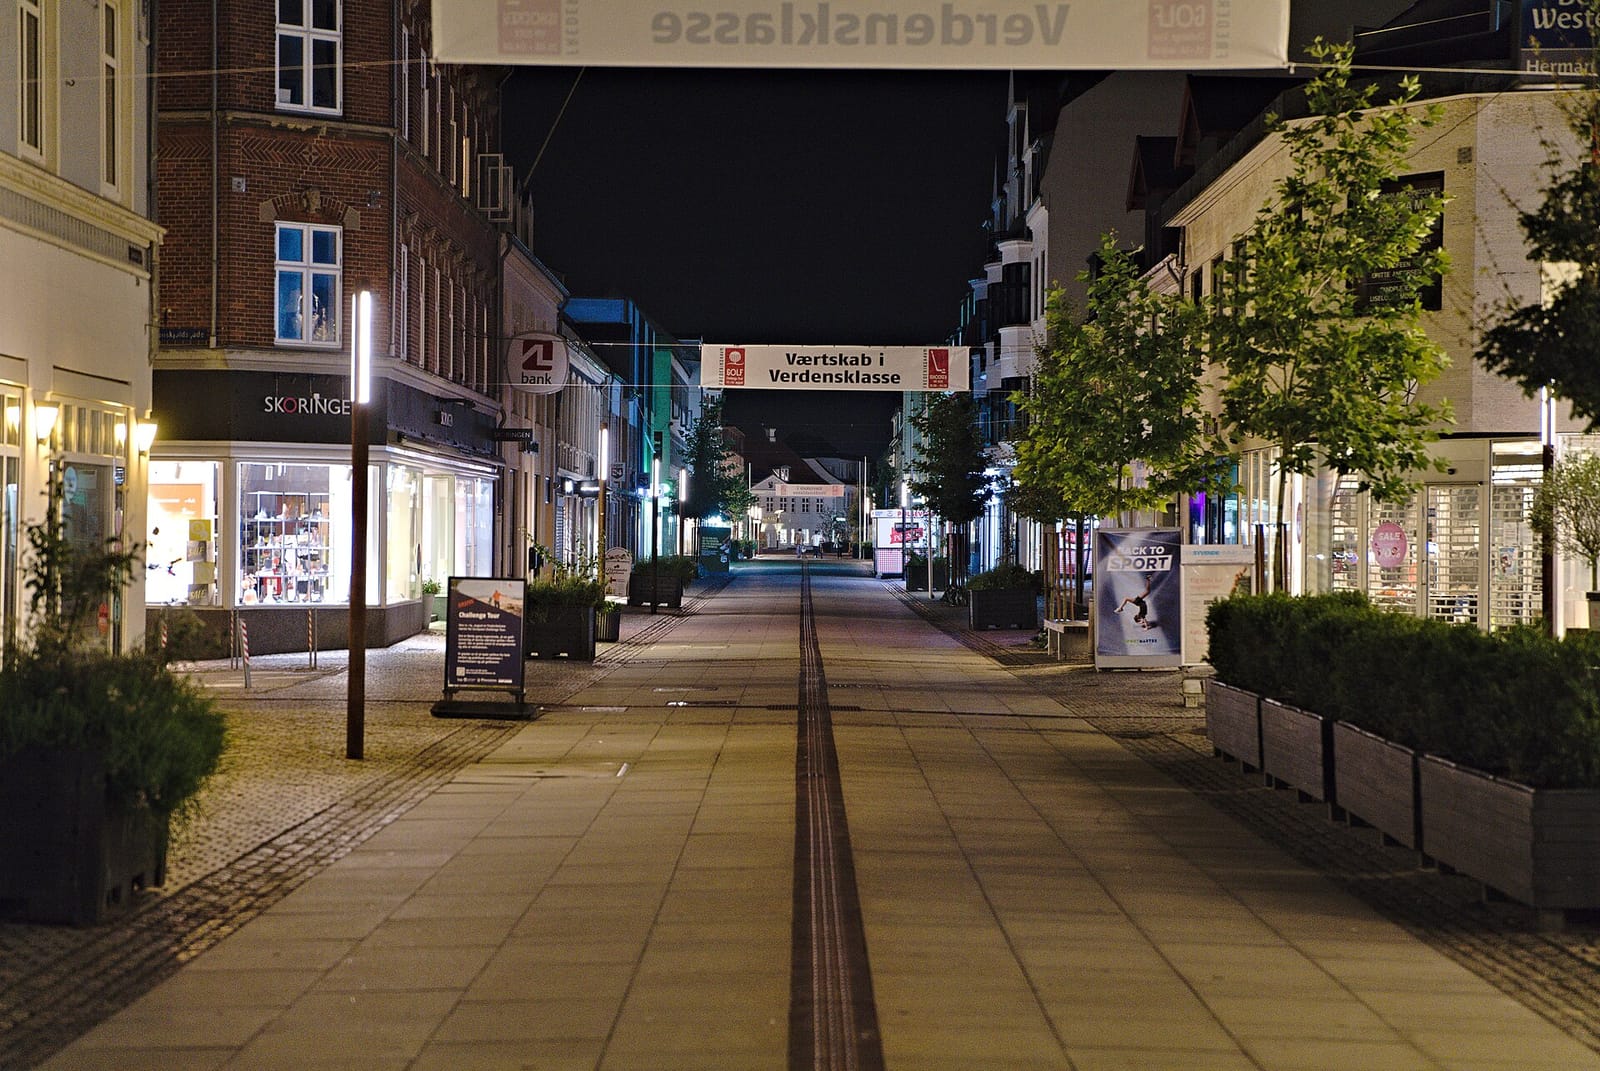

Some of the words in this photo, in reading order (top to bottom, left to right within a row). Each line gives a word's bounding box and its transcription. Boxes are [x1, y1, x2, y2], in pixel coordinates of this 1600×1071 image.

[786, 352, 873, 366] Værtskab
[879, 352, 885, 366] i
[521, 371, 552, 384] bank
[726, 368, 744, 377] GOLF
[769, 369, 901, 384] Verdensklasse
[264, 396, 351, 415] SKORINGE
[1149, 545, 1165, 555] TO
[1108, 557, 1170, 570] SPORT
